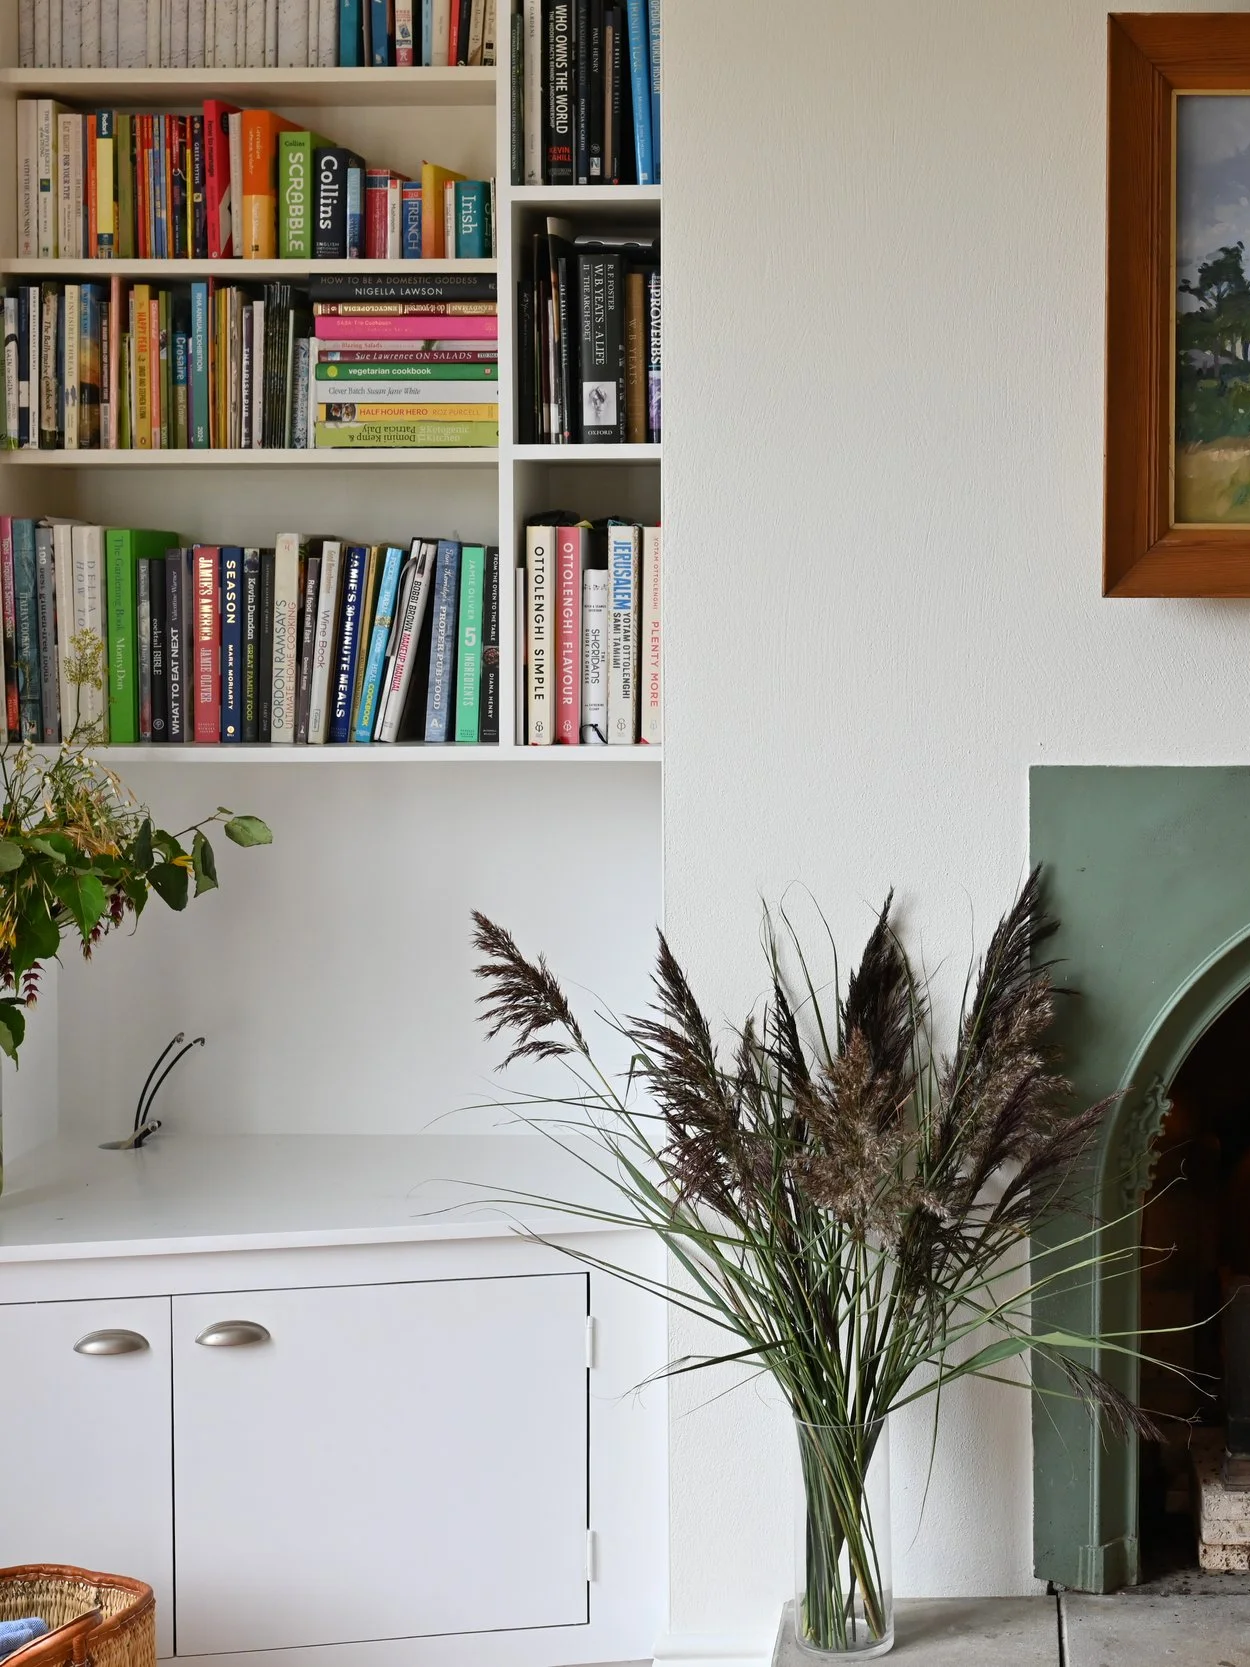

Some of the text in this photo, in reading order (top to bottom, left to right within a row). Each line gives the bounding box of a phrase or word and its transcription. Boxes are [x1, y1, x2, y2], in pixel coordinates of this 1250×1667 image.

[651, 28, 659, 39] OF
[555, 5, 568, 133] WHO OWNS THE WORLD
[286, 153, 304, 251] SCRABBLE
[320, 156, 338, 229] Collins
[408, 202, 419, 250] FRENCH
[462, 196, 477, 234] Irish
[138, 312, 146, 335] HAPPY
[595, 289, 604, 365] YEATS LIFE
[650, 289, 660, 364] PROVERBS
[176, 337, 185, 380] Crosaire
[43, 376, 52, 410] Cookbook
[114, 537, 123, 554] The
[113, 556, 123, 606] Gardening
[199, 557, 213, 595] JAMIE'S
[226, 560, 235, 623] SEASON
[247, 578, 256, 602] Kevin
[306, 580, 315, 595] Real
[613, 541, 631, 610] JERUSALEM
[116, 609, 124, 631] Book
[247, 605, 255, 640] Dundon
[305, 614, 313, 628] real
[306, 597, 314, 613] food
[491, 600, 496, 610] TO
[534, 546, 544, 700] OTTOLENGHI SIMPLE
[563, 542, 573, 705] OTTOLENGHI FLAVOUR
[304, 629, 312, 643] fast
[317, 610, 330, 668] Wine Book
[341, 605, 355, 670] 30-MINUTE
[391, 580, 422, 692] BOBBI BROWN MAKEUP MANUAL
[438, 605, 446, 650] PROPER
[465, 627, 475, 646] 5
[622, 613, 630, 642] YOTAM
[651, 621, 659, 668] PLENTY
[114, 638, 124, 667] Monty
[201, 648, 211, 673] JAMIE
[273, 600, 286, 729] GORDON RAMSAY'S
[285, 602, 296, 729] ULTIMATE HOME COOKING
[201, 675, 212, 703] OLIVER
[336, 674, 352, 717] MEALS
[433, 678, 442, 710] FOOD
[463, 653, 474, 706] INGREDIENTS
[362, 683, 375, 726] COOKBOOK
